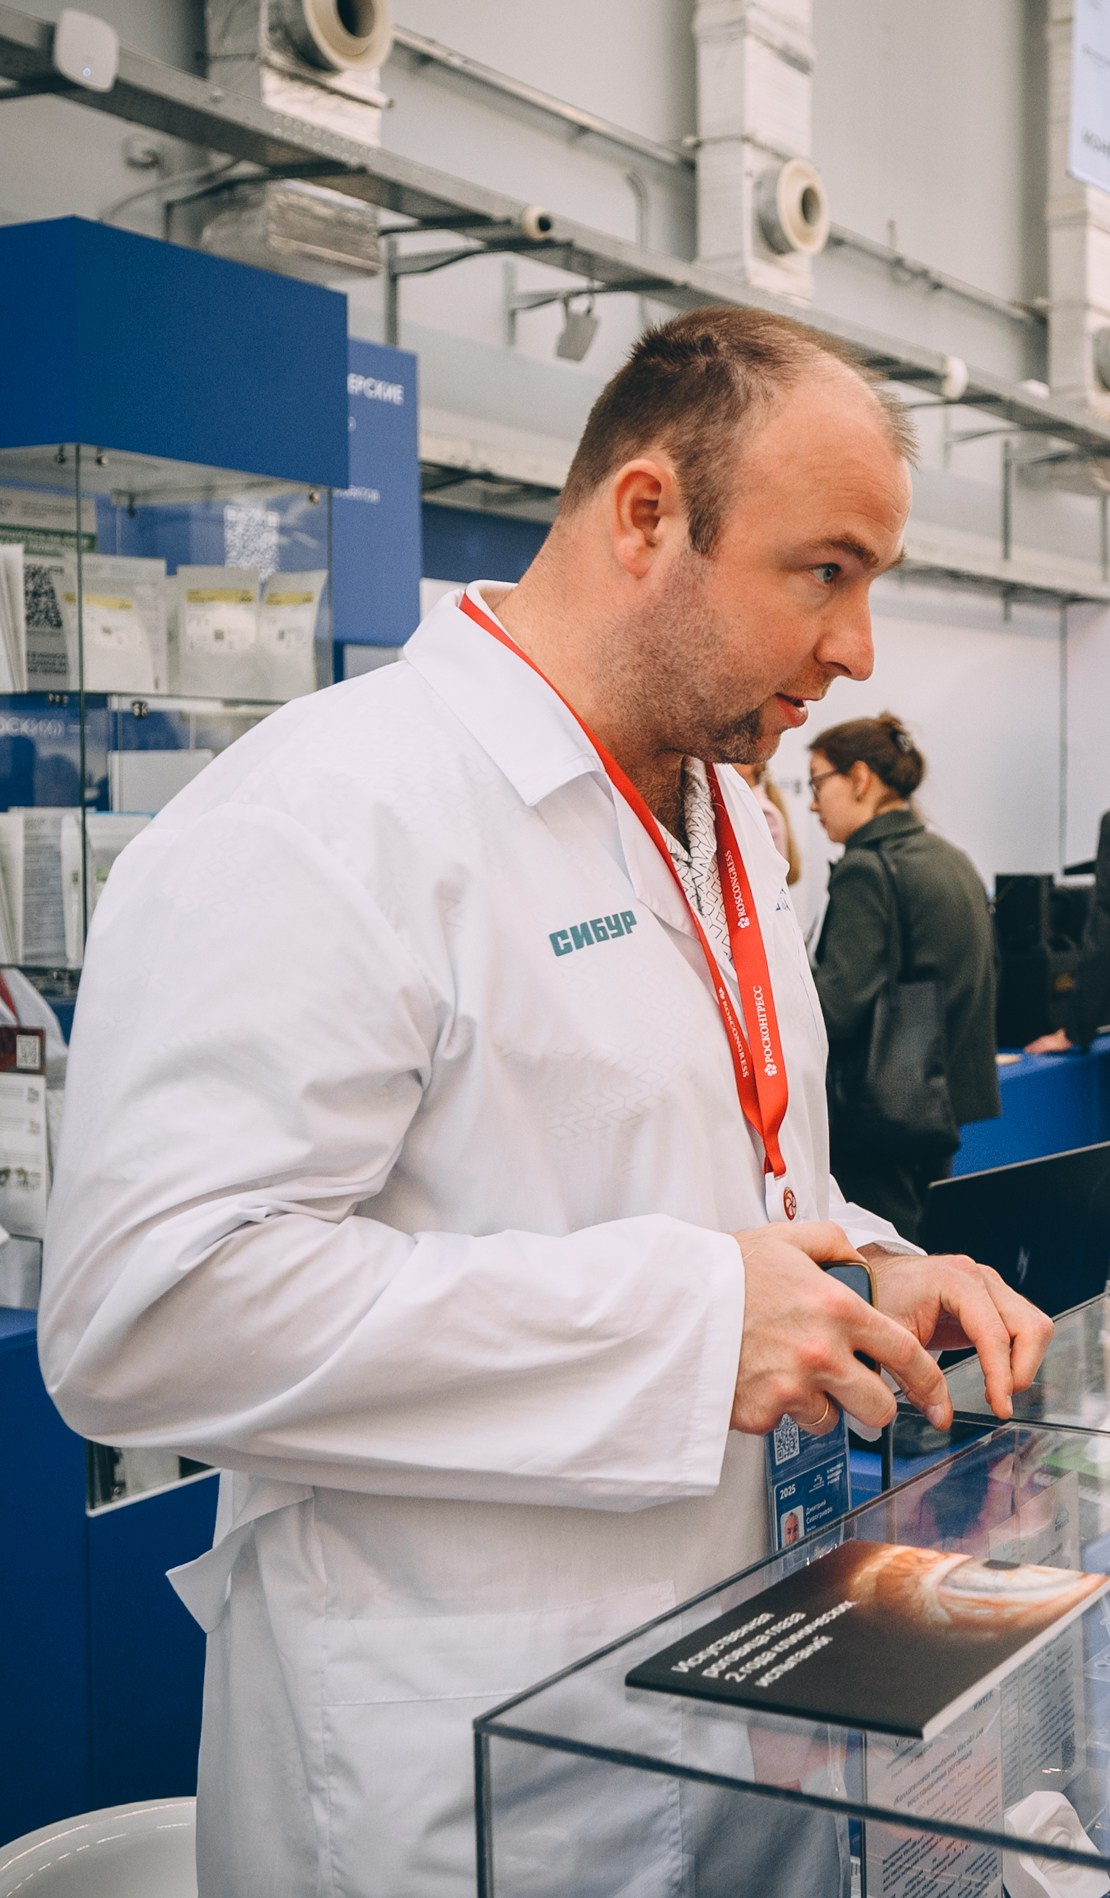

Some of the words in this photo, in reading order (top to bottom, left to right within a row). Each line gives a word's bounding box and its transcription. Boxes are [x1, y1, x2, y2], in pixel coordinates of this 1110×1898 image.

[725, 850, 747, 918] ROSCONGRESS
[549, 910, 637, 957] СИБУР
[722, 1000, 749, 1078] ROSCONGRESS
[753, 985, 775, 1063] РОСКОНГРЕСС
[780, 1484, 796, 1500] 2025
[702, 1635, 771, 1678] роговица
[725, 1671, 747, 1683] 2
[755, 1635, 834, 1687] испытаний
